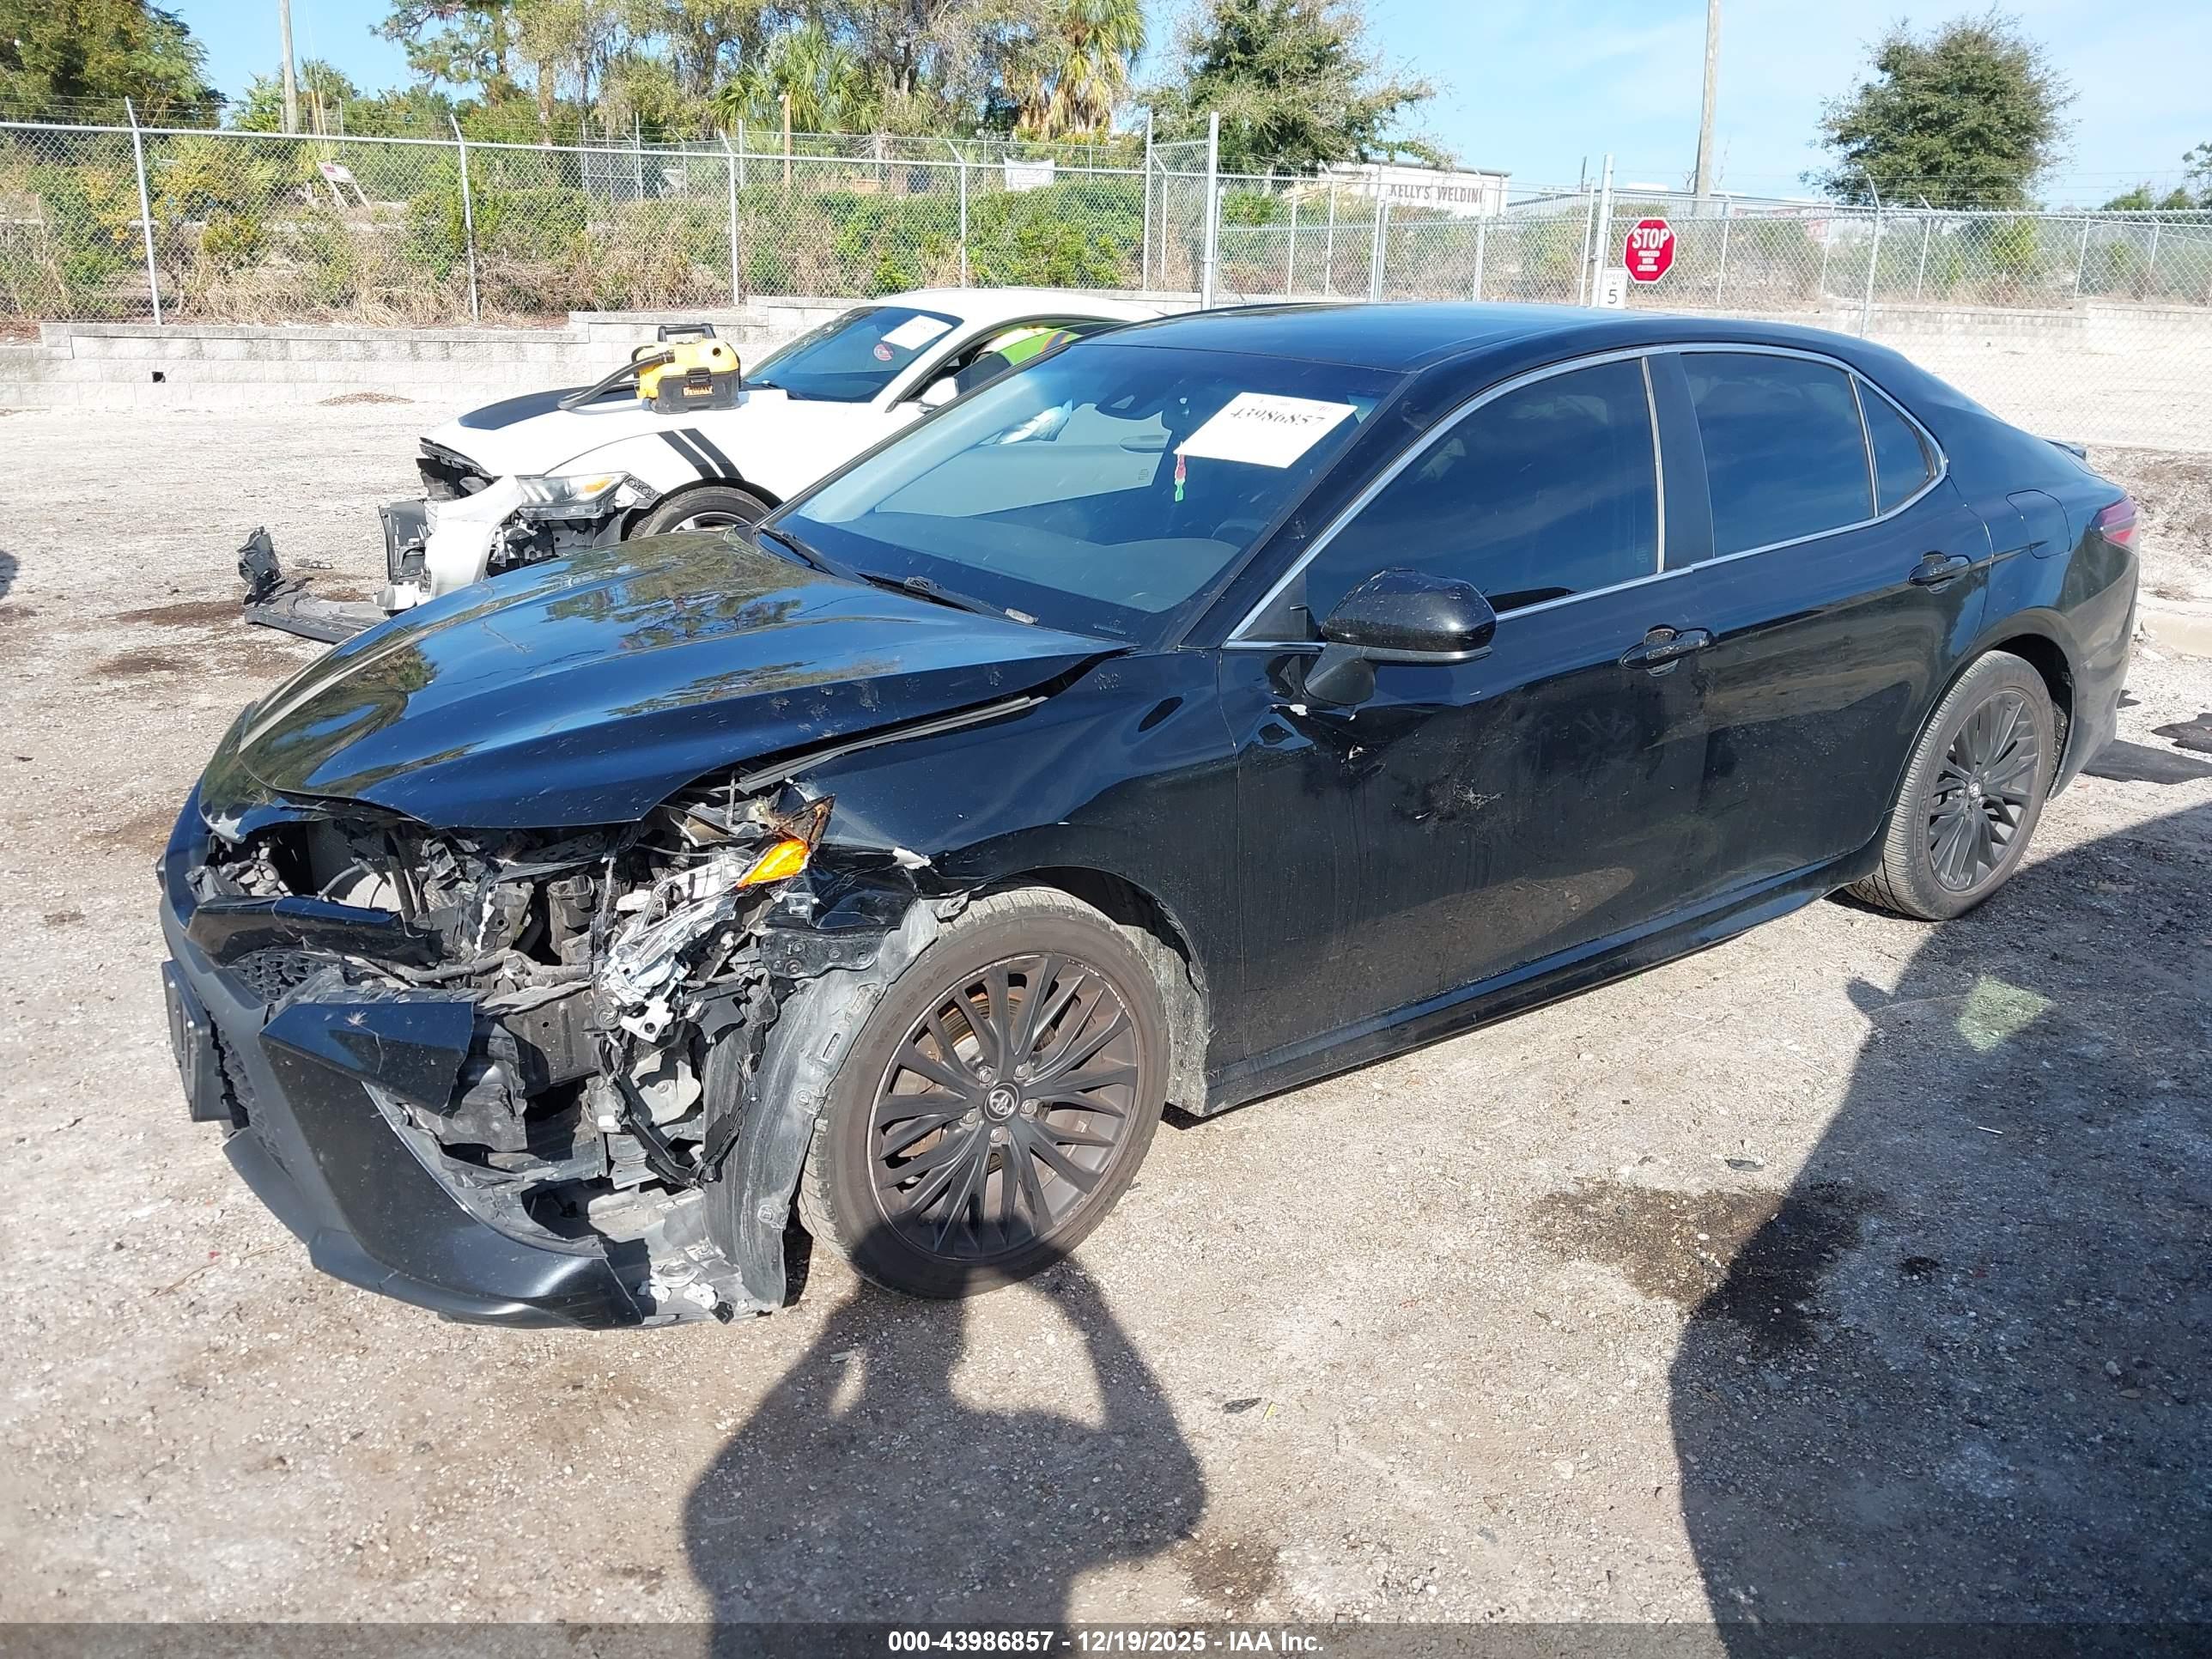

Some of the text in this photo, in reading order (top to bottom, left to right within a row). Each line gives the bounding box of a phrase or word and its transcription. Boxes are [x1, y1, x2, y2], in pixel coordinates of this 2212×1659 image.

[1389, 185, 1431, 200] KELLY'S
[1632, 228, 1670, 249] STOP
[1607, 289, 1618, 304] 5
